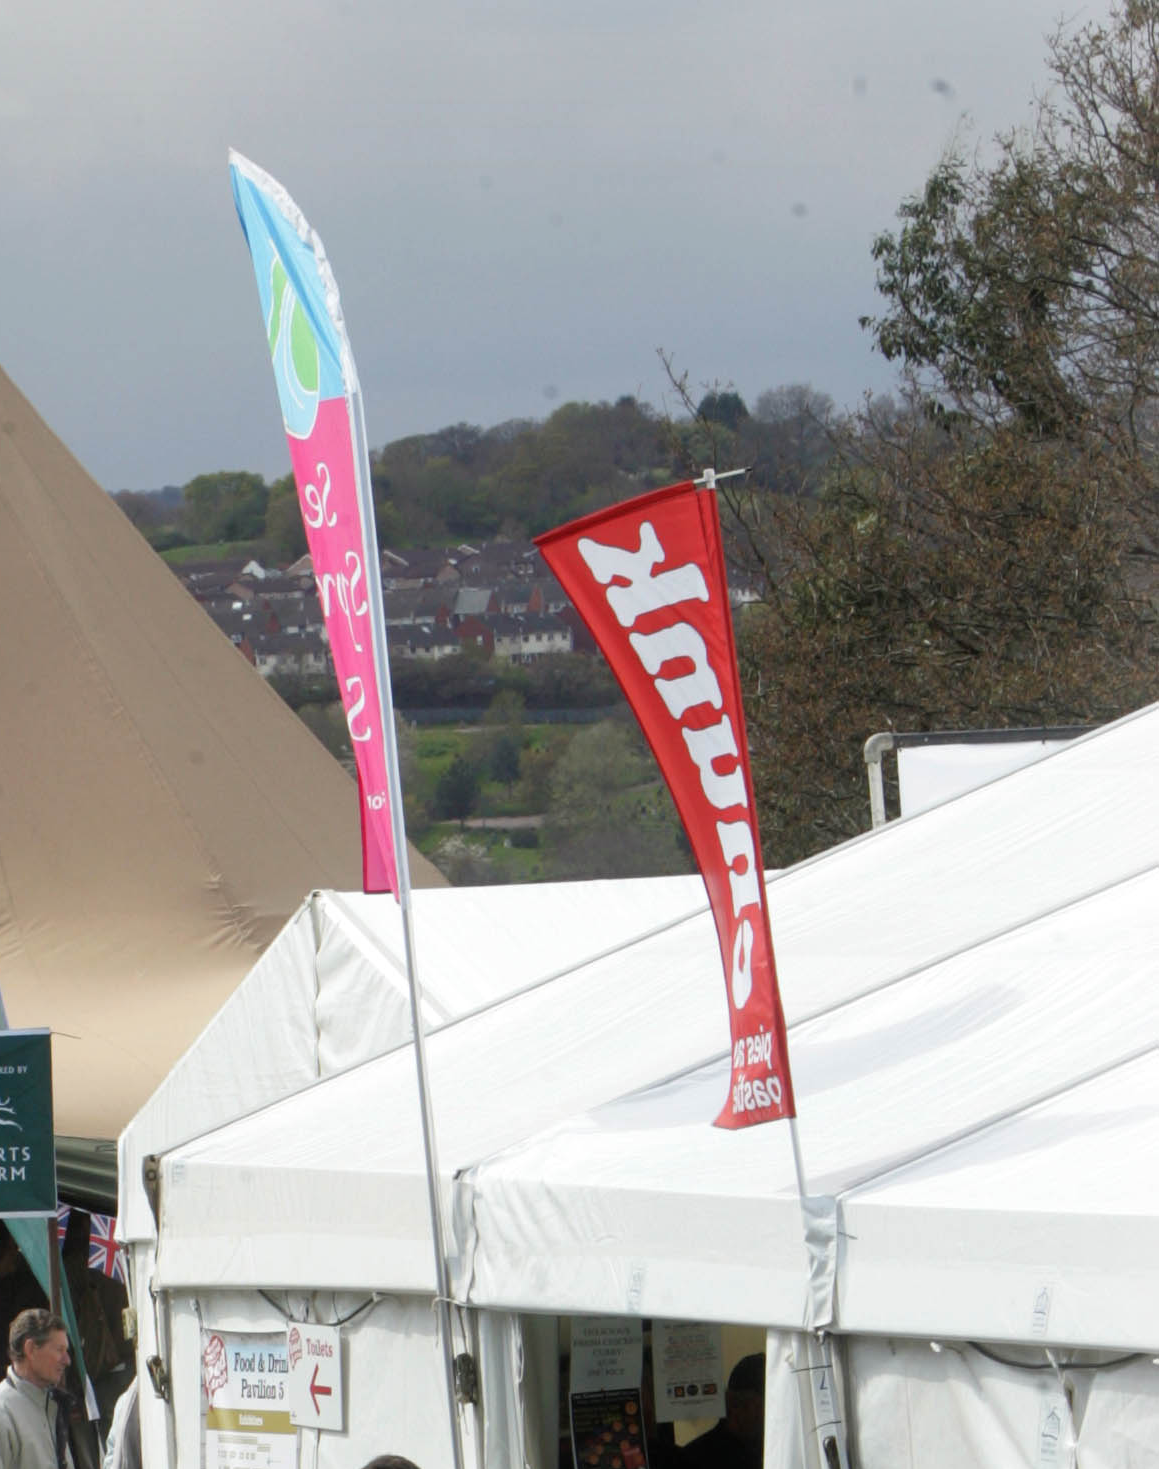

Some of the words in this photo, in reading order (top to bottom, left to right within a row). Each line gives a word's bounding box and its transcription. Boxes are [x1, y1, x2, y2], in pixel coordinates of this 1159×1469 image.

[17, 1065, 28, 1073] BY
[306, 1337, 333, 1358] Toilets
[234, 1352, 255, 1372] Food
[258, 1353, 265, 1373] &
[268, 1353, 289, 1373] Drin
[241, 1378, 276, 1399] Pavilion
[279, 1381, 284, 1400] 5
